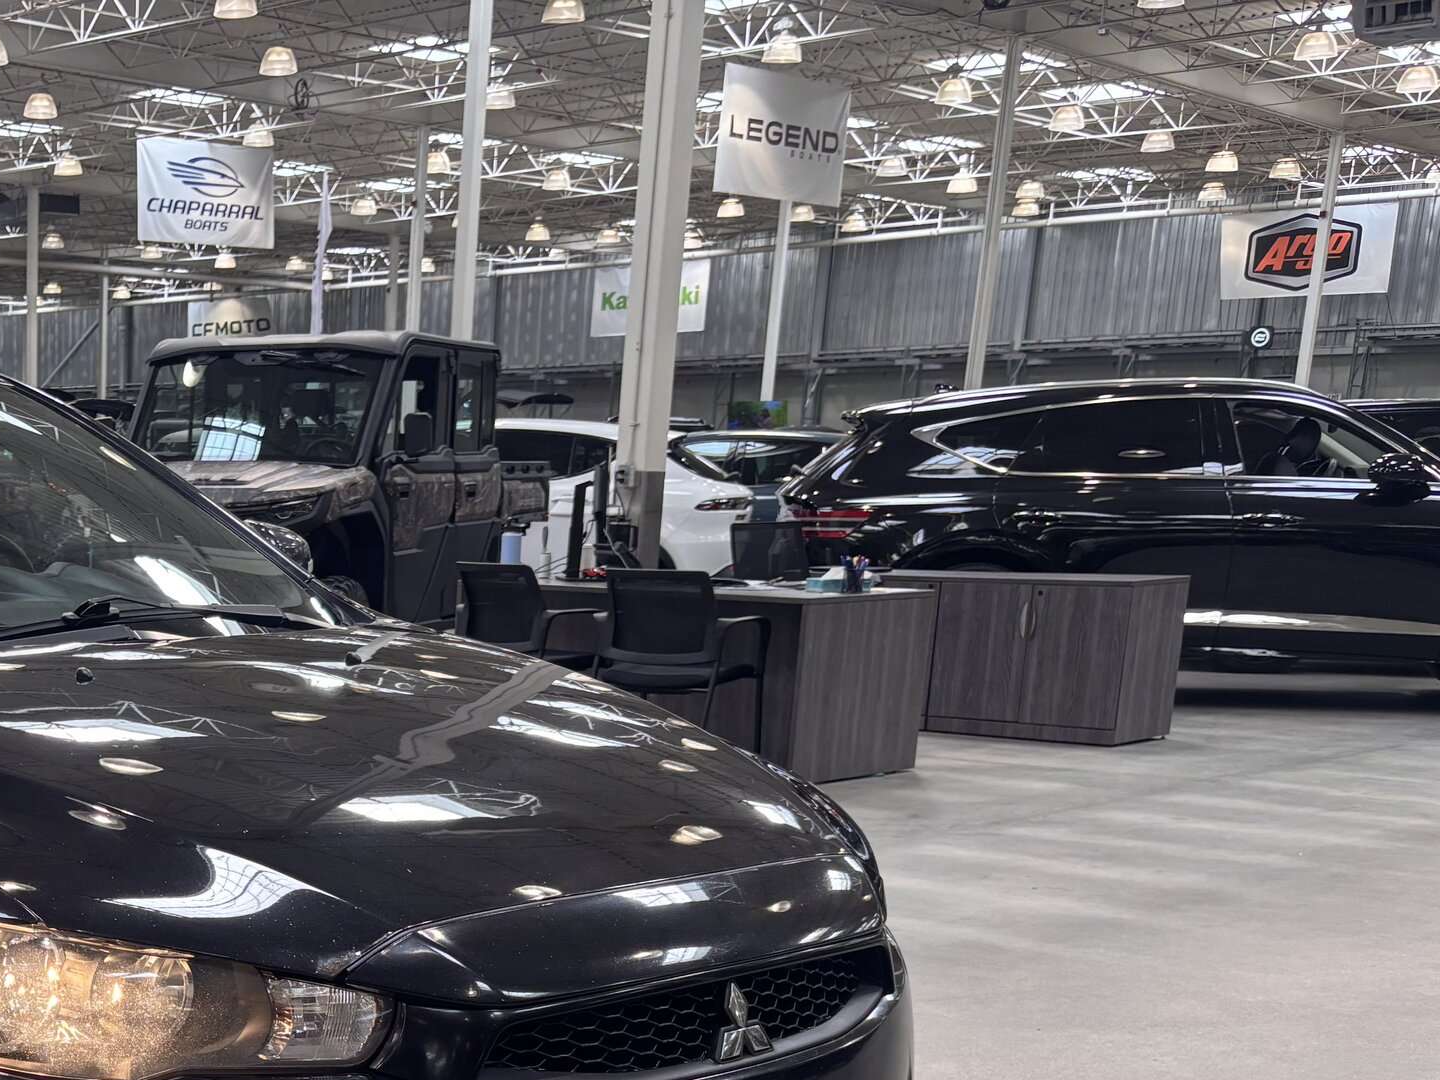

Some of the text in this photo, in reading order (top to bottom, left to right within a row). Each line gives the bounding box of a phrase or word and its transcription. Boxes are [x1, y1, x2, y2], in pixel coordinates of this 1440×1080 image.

[729, 114, 839, 154] LEGEND
[147, 198, 264, 220] CHAPARRAL
[184, 219, 229, 231] BOATS
[192, 318, 271, 337] CFMOTO
